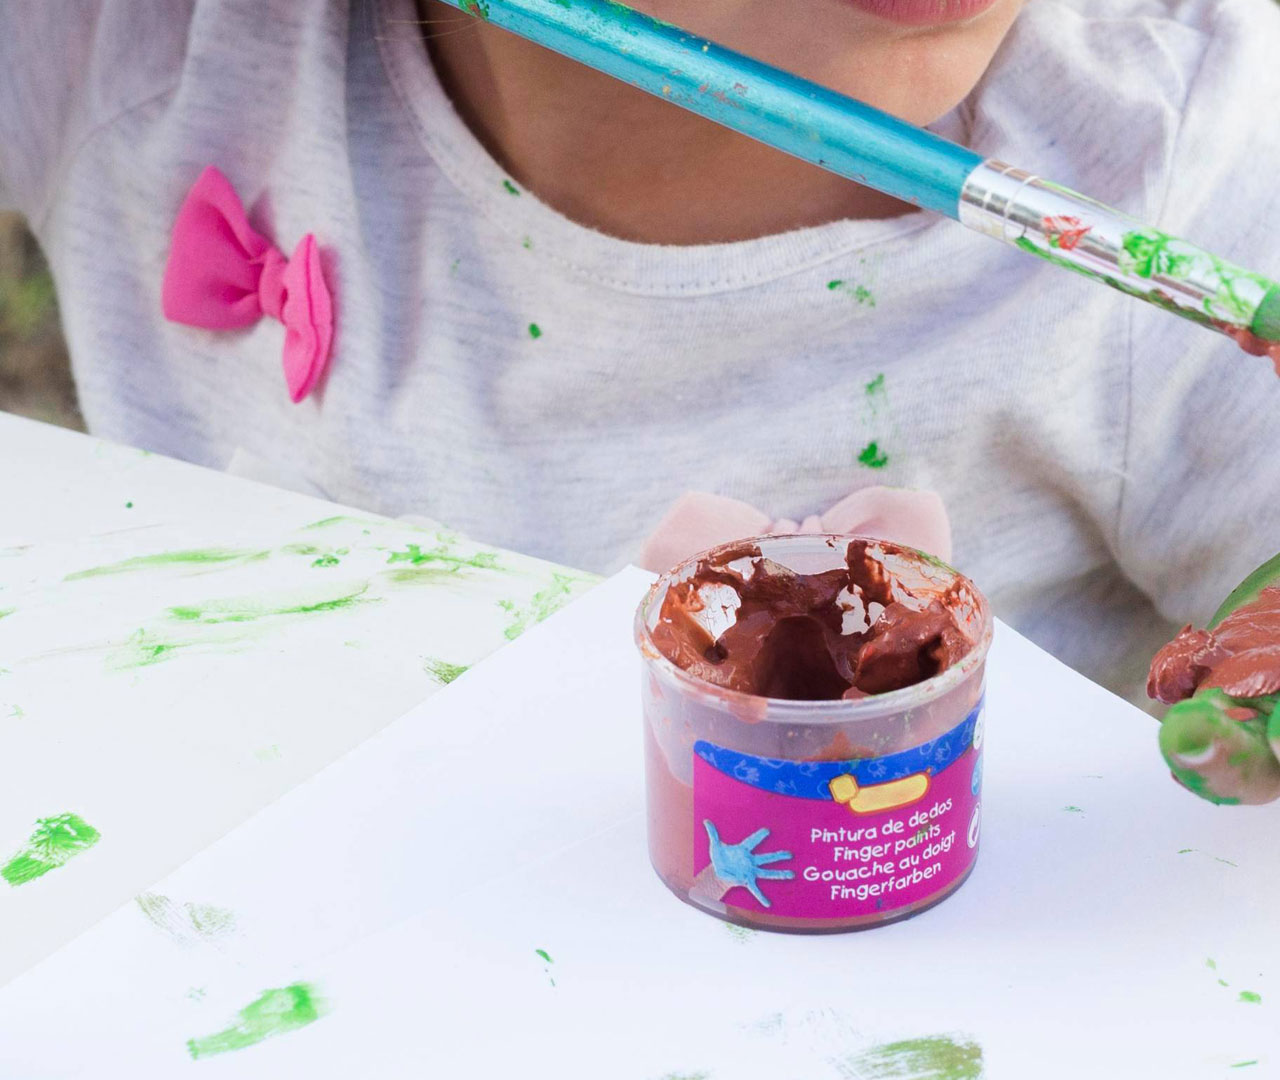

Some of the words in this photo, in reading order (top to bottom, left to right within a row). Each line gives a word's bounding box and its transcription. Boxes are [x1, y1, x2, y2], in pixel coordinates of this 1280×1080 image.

[811, 827, 877, 843] Pintura
[881, 819, 904, 835] de
[908, 798, 953, 827] dedos
[803, 861, 895, 881] Gouache
[899, 854, 919, 869] au
[922, 830, 956, 860] doigt
[834, 842, 891, 862] Finger
[894, 824, 941, 855] paints
[830, 862, 942, 900] Fingerfarben
